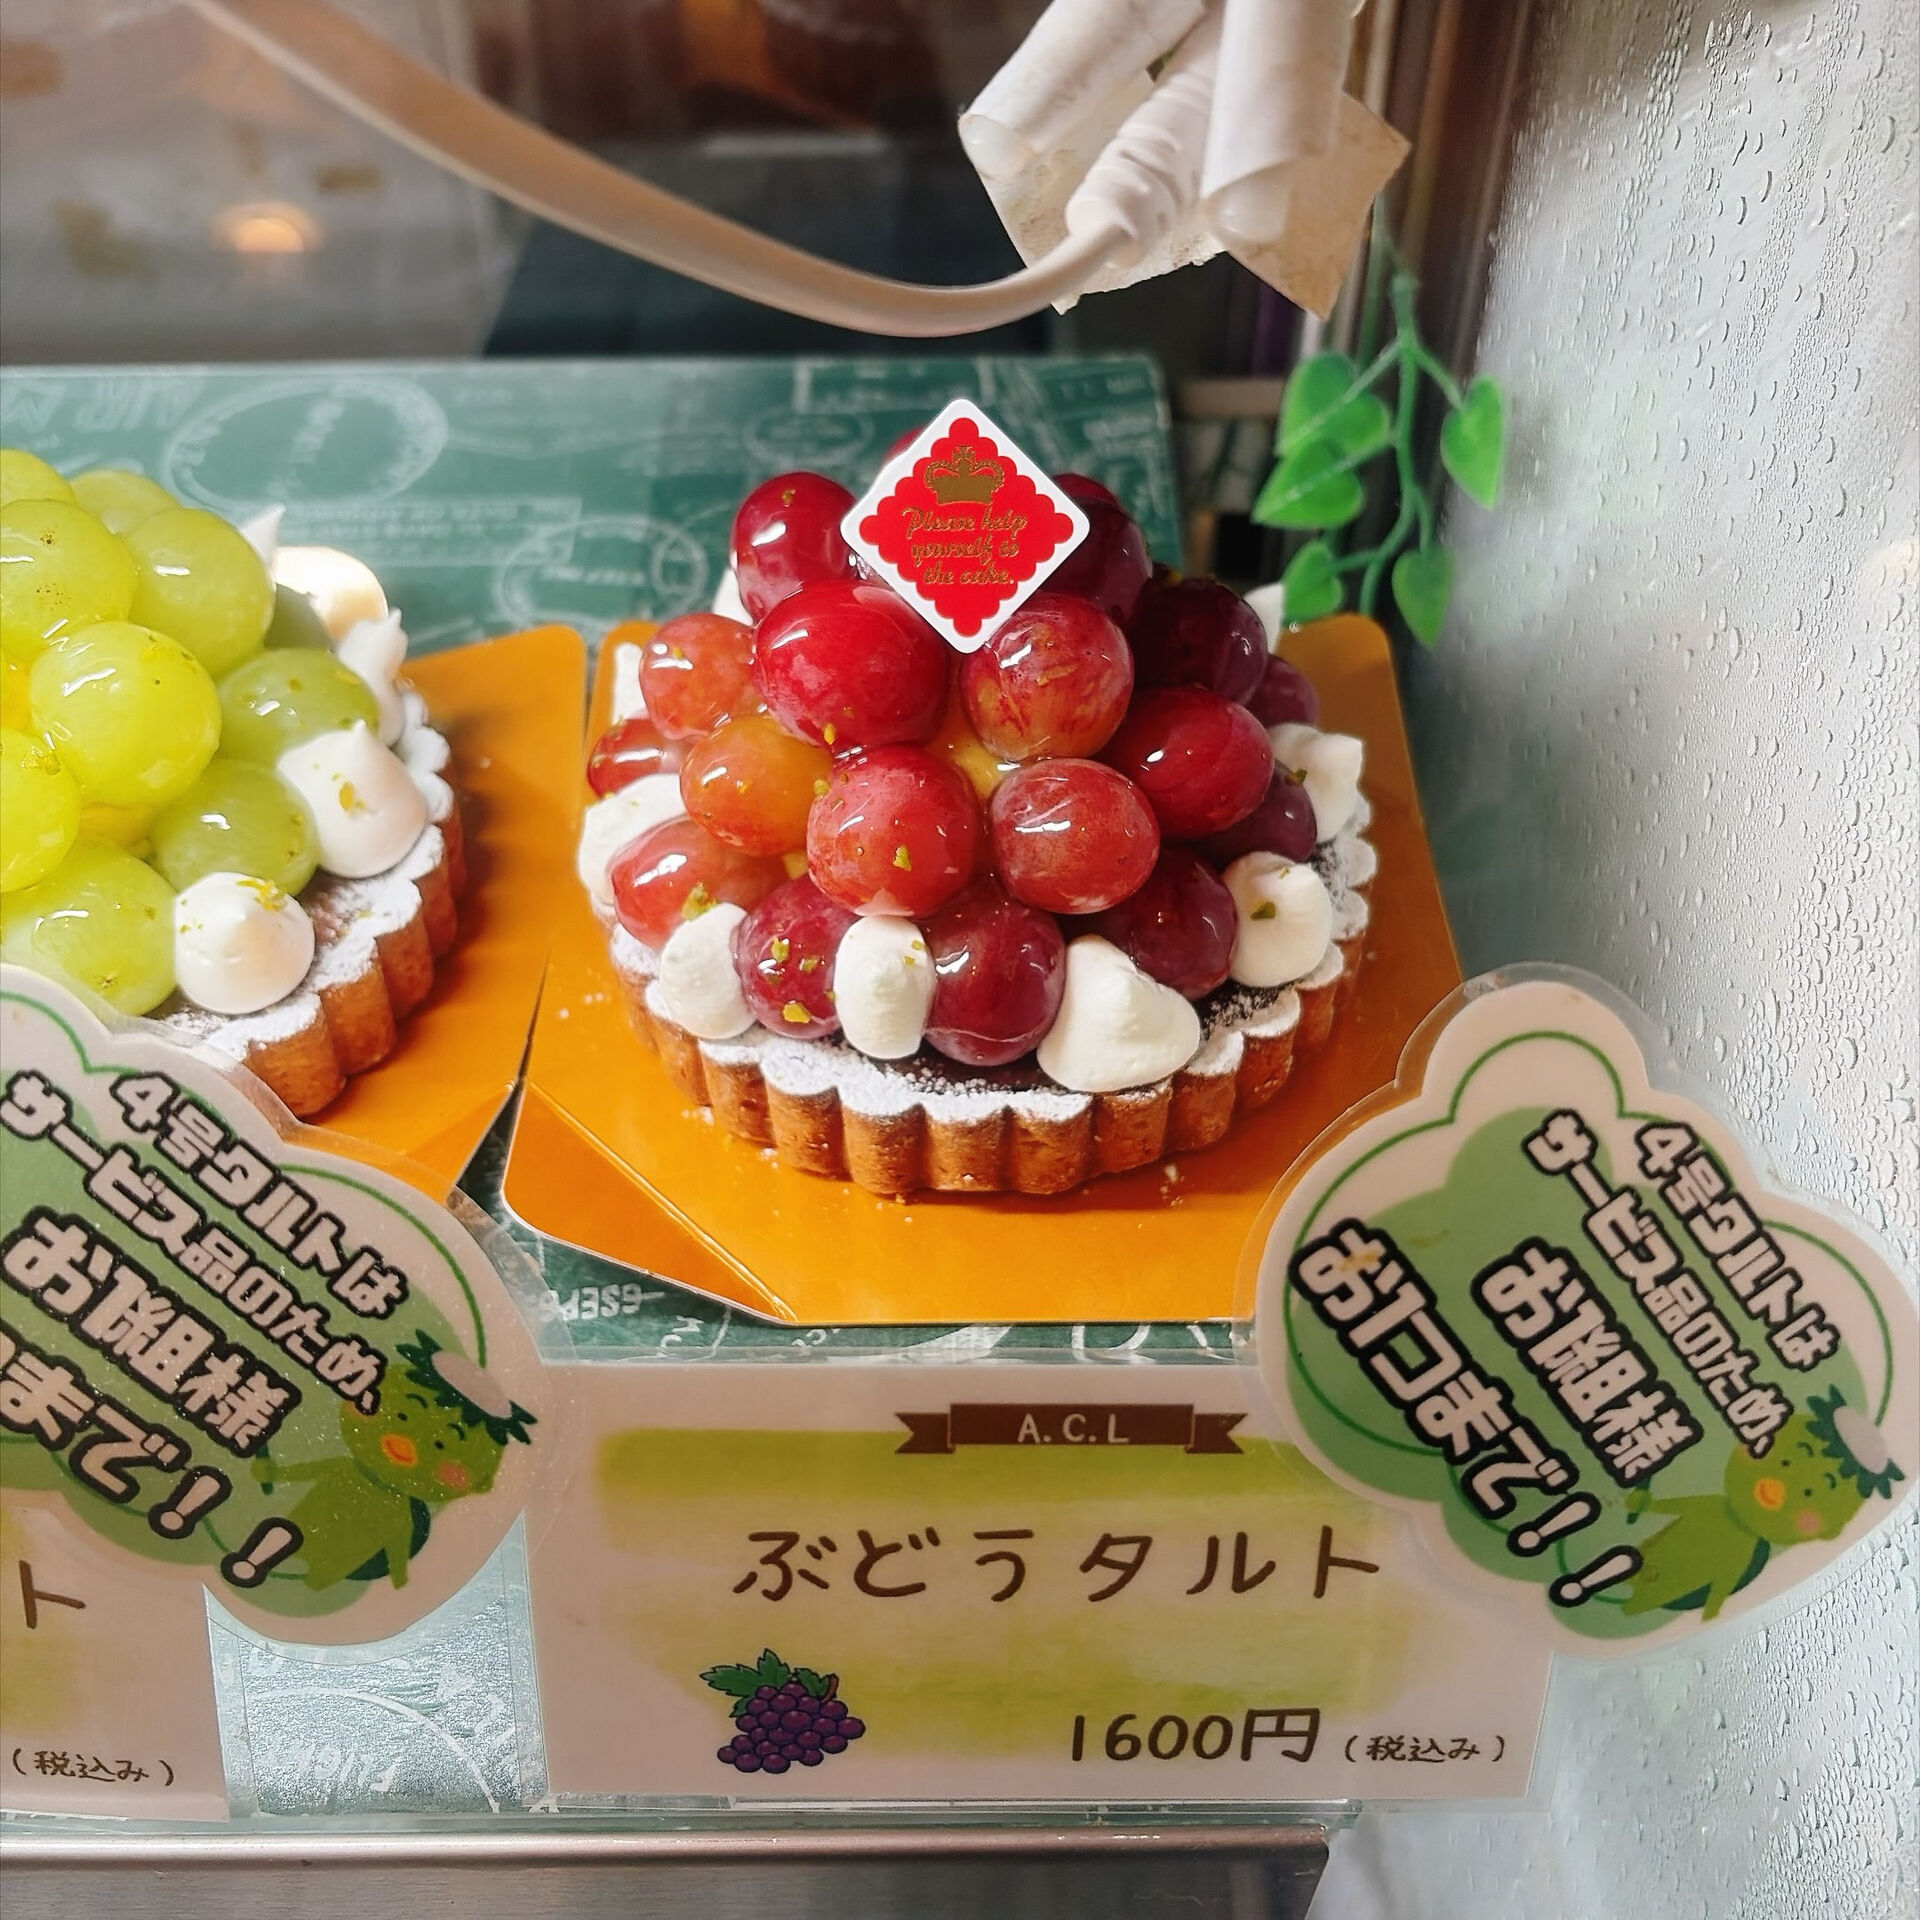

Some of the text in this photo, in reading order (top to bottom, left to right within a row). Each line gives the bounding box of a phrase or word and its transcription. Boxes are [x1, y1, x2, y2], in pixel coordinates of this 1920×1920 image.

[902, 505, 1028, 540] Please help
[911, 533, 1020, 568] yourself to
[923, 561, 1015, 585] the cake.
[111, 1072, 410, 1319] 4号タルトは
[0, 1069, 387, 1415] サービス品のため、
[1635, 1122, 1840, 1370] 4号タルトは
[1521, 1109, 1793, 1458] サービス品のため、
[0, 1325, 303, 1587] まで！！
[1018, 1413, 1129, 1443] A.C.L
[732, 1525, 1380, 1602] ぶどうタルト
[1071, 1708, 1321, 1762] 1600円
